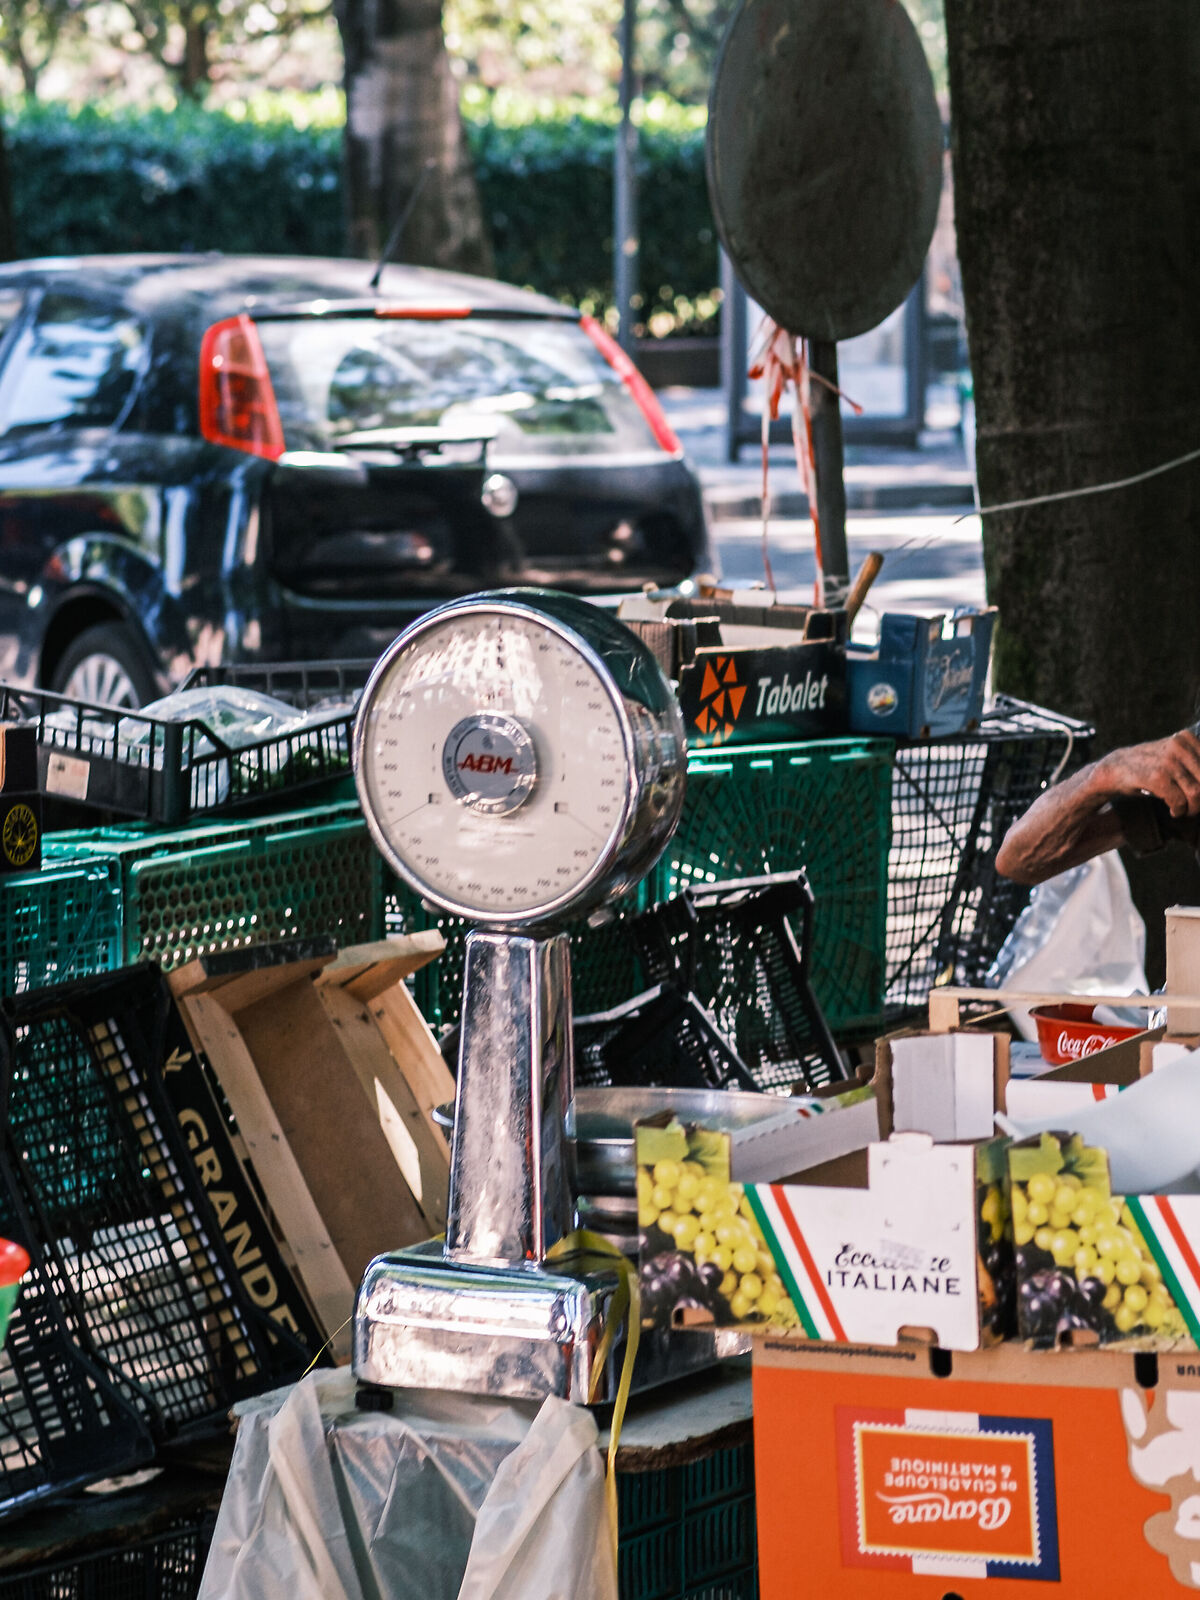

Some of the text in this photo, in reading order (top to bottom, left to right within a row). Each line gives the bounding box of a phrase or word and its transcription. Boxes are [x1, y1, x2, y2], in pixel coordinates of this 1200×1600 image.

[756, 671, 828, 716] Tabalet
[459, 752, 514, 776] ABM
[178, 1108, 299, 1345] GRANDE
[827, 1270, 960, 1295] ITALIANE
[889, 1456, 997, 1478] MARTINIQUE
[883, 1472, 997, 1495] GUADELOUPE
[875, 1491, 1012, 1531] Banane
